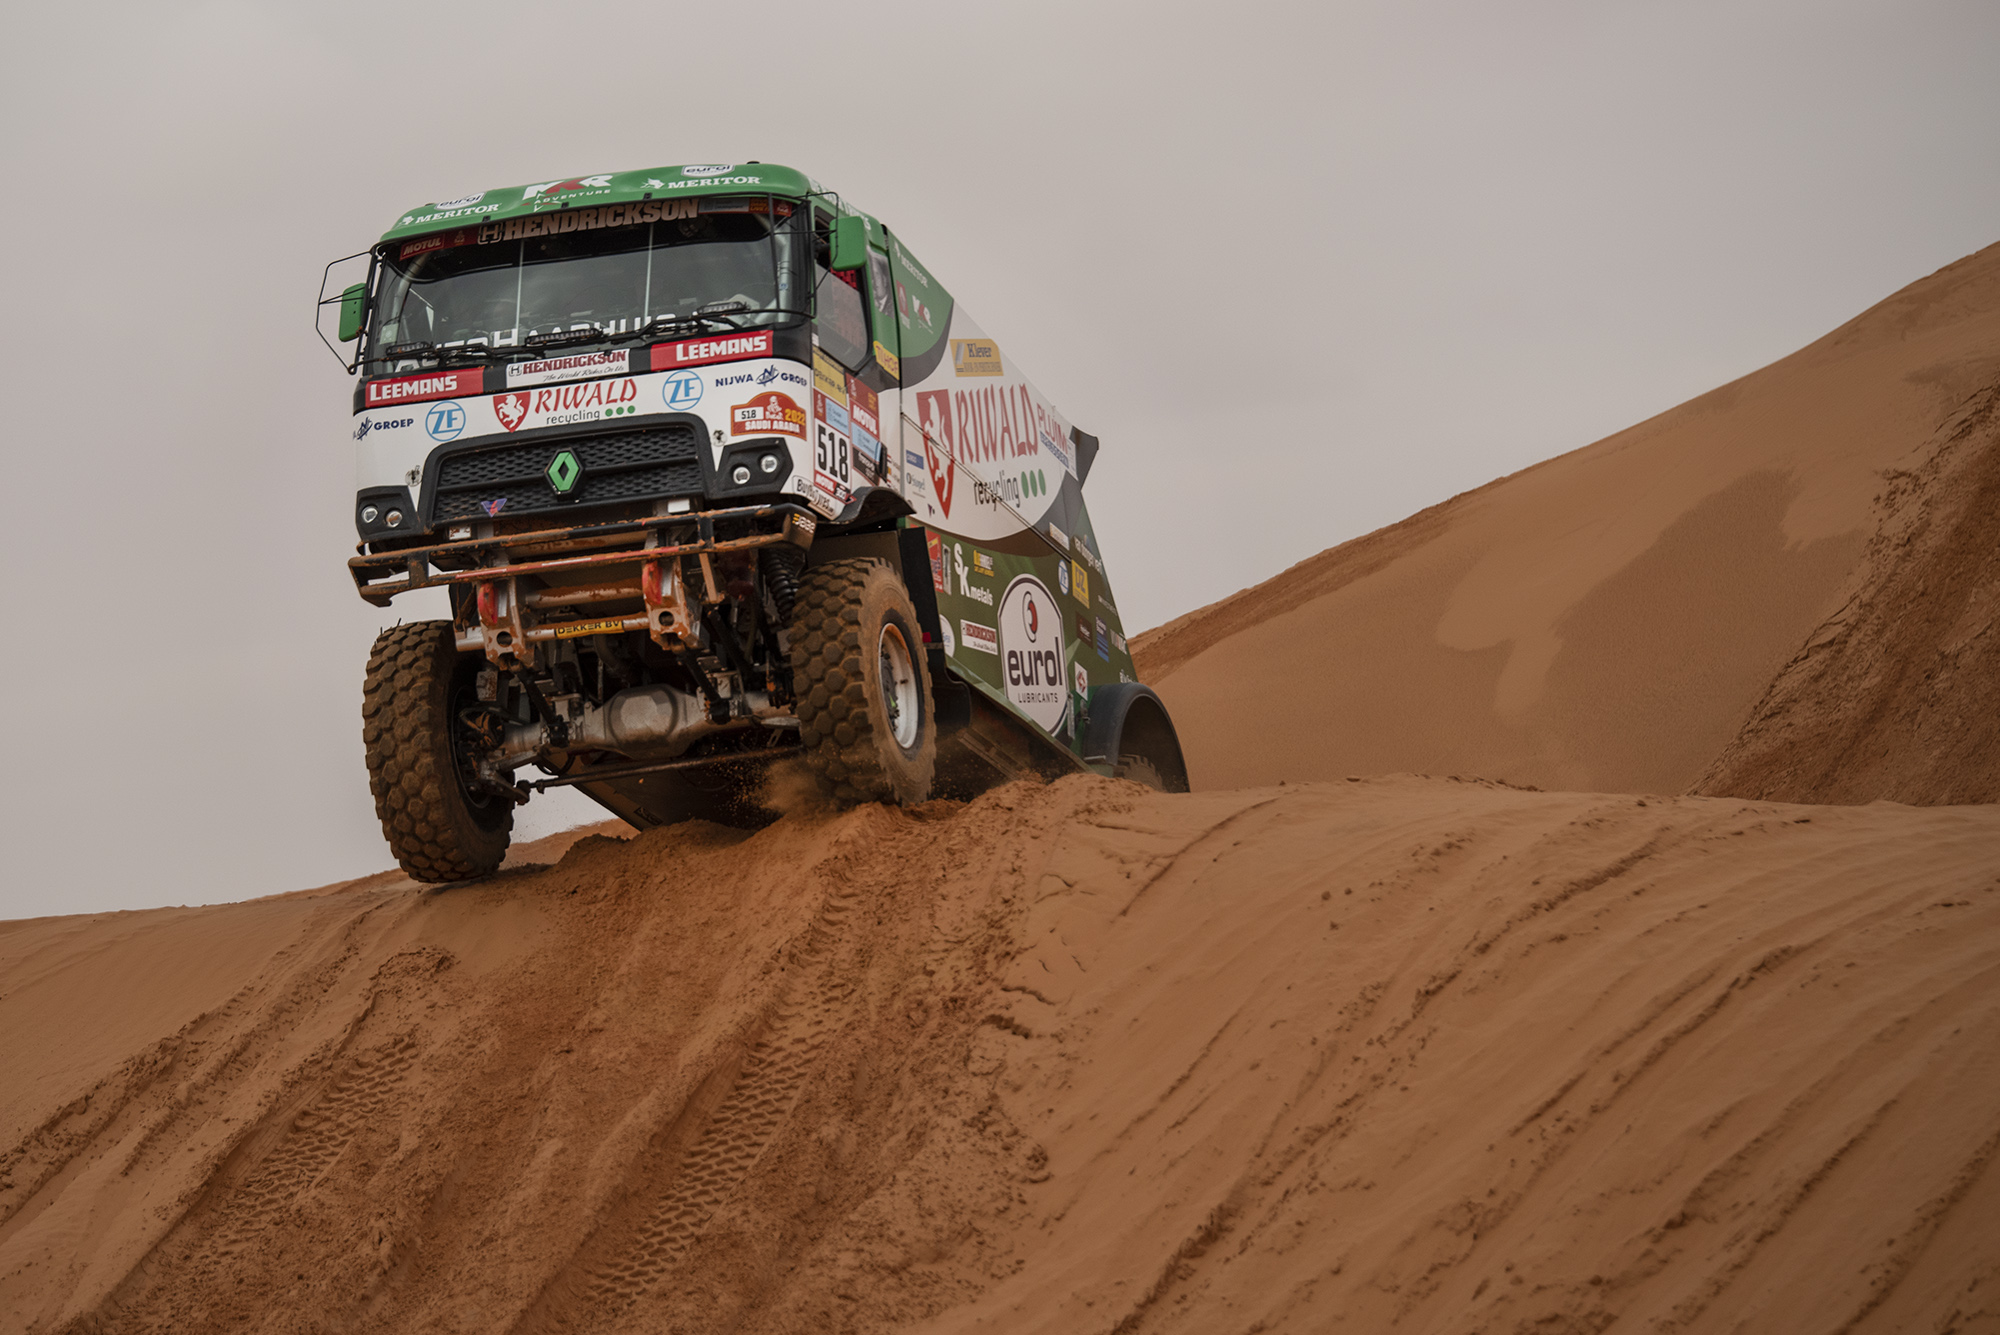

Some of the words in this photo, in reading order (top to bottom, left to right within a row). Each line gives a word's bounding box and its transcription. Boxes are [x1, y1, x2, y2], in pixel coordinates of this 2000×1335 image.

[668, 176, 760, 189] MERITOR
[534, 189, 611, 204] ADVENTURE
[415, 203, 500, 224] MERITOR
[502, 199, 699, 241] HENDRICKSON
[403, 237, 442, 255] MOTUL
[676, 336, 767, 361] LEEMANS
[523, 351, 627, 374] HENDRICKSON
[370, 375, 457, 401] LEEMANS
[715, 373, 754, 387] NIJWA
[781, 372, 807, 387] GROEP
[534, 378, 637, 414] RIWALD
[666, 375, 701, 405] ZF
[374, 418, 414, 430] GROEP
[429, 406, 463, 436] ZF
[546, 409, 600, 425] recycling
[741, 409, 757, 419] 518
[784, 408, 806, 426] 2022
[955, 383, 1038, 464] RIWALD
[745, 420, 771, 430] SAUDI
[772, 420, 800, 433] ARABIA
[818, 424, 848, 483] 518
[970, 586, 993, 606] metals
[605, 620, 620, 629] BV
[1007, 636, 1063, 686] eurol
[1017, 692, 1059, 704] LUBRICANTS
